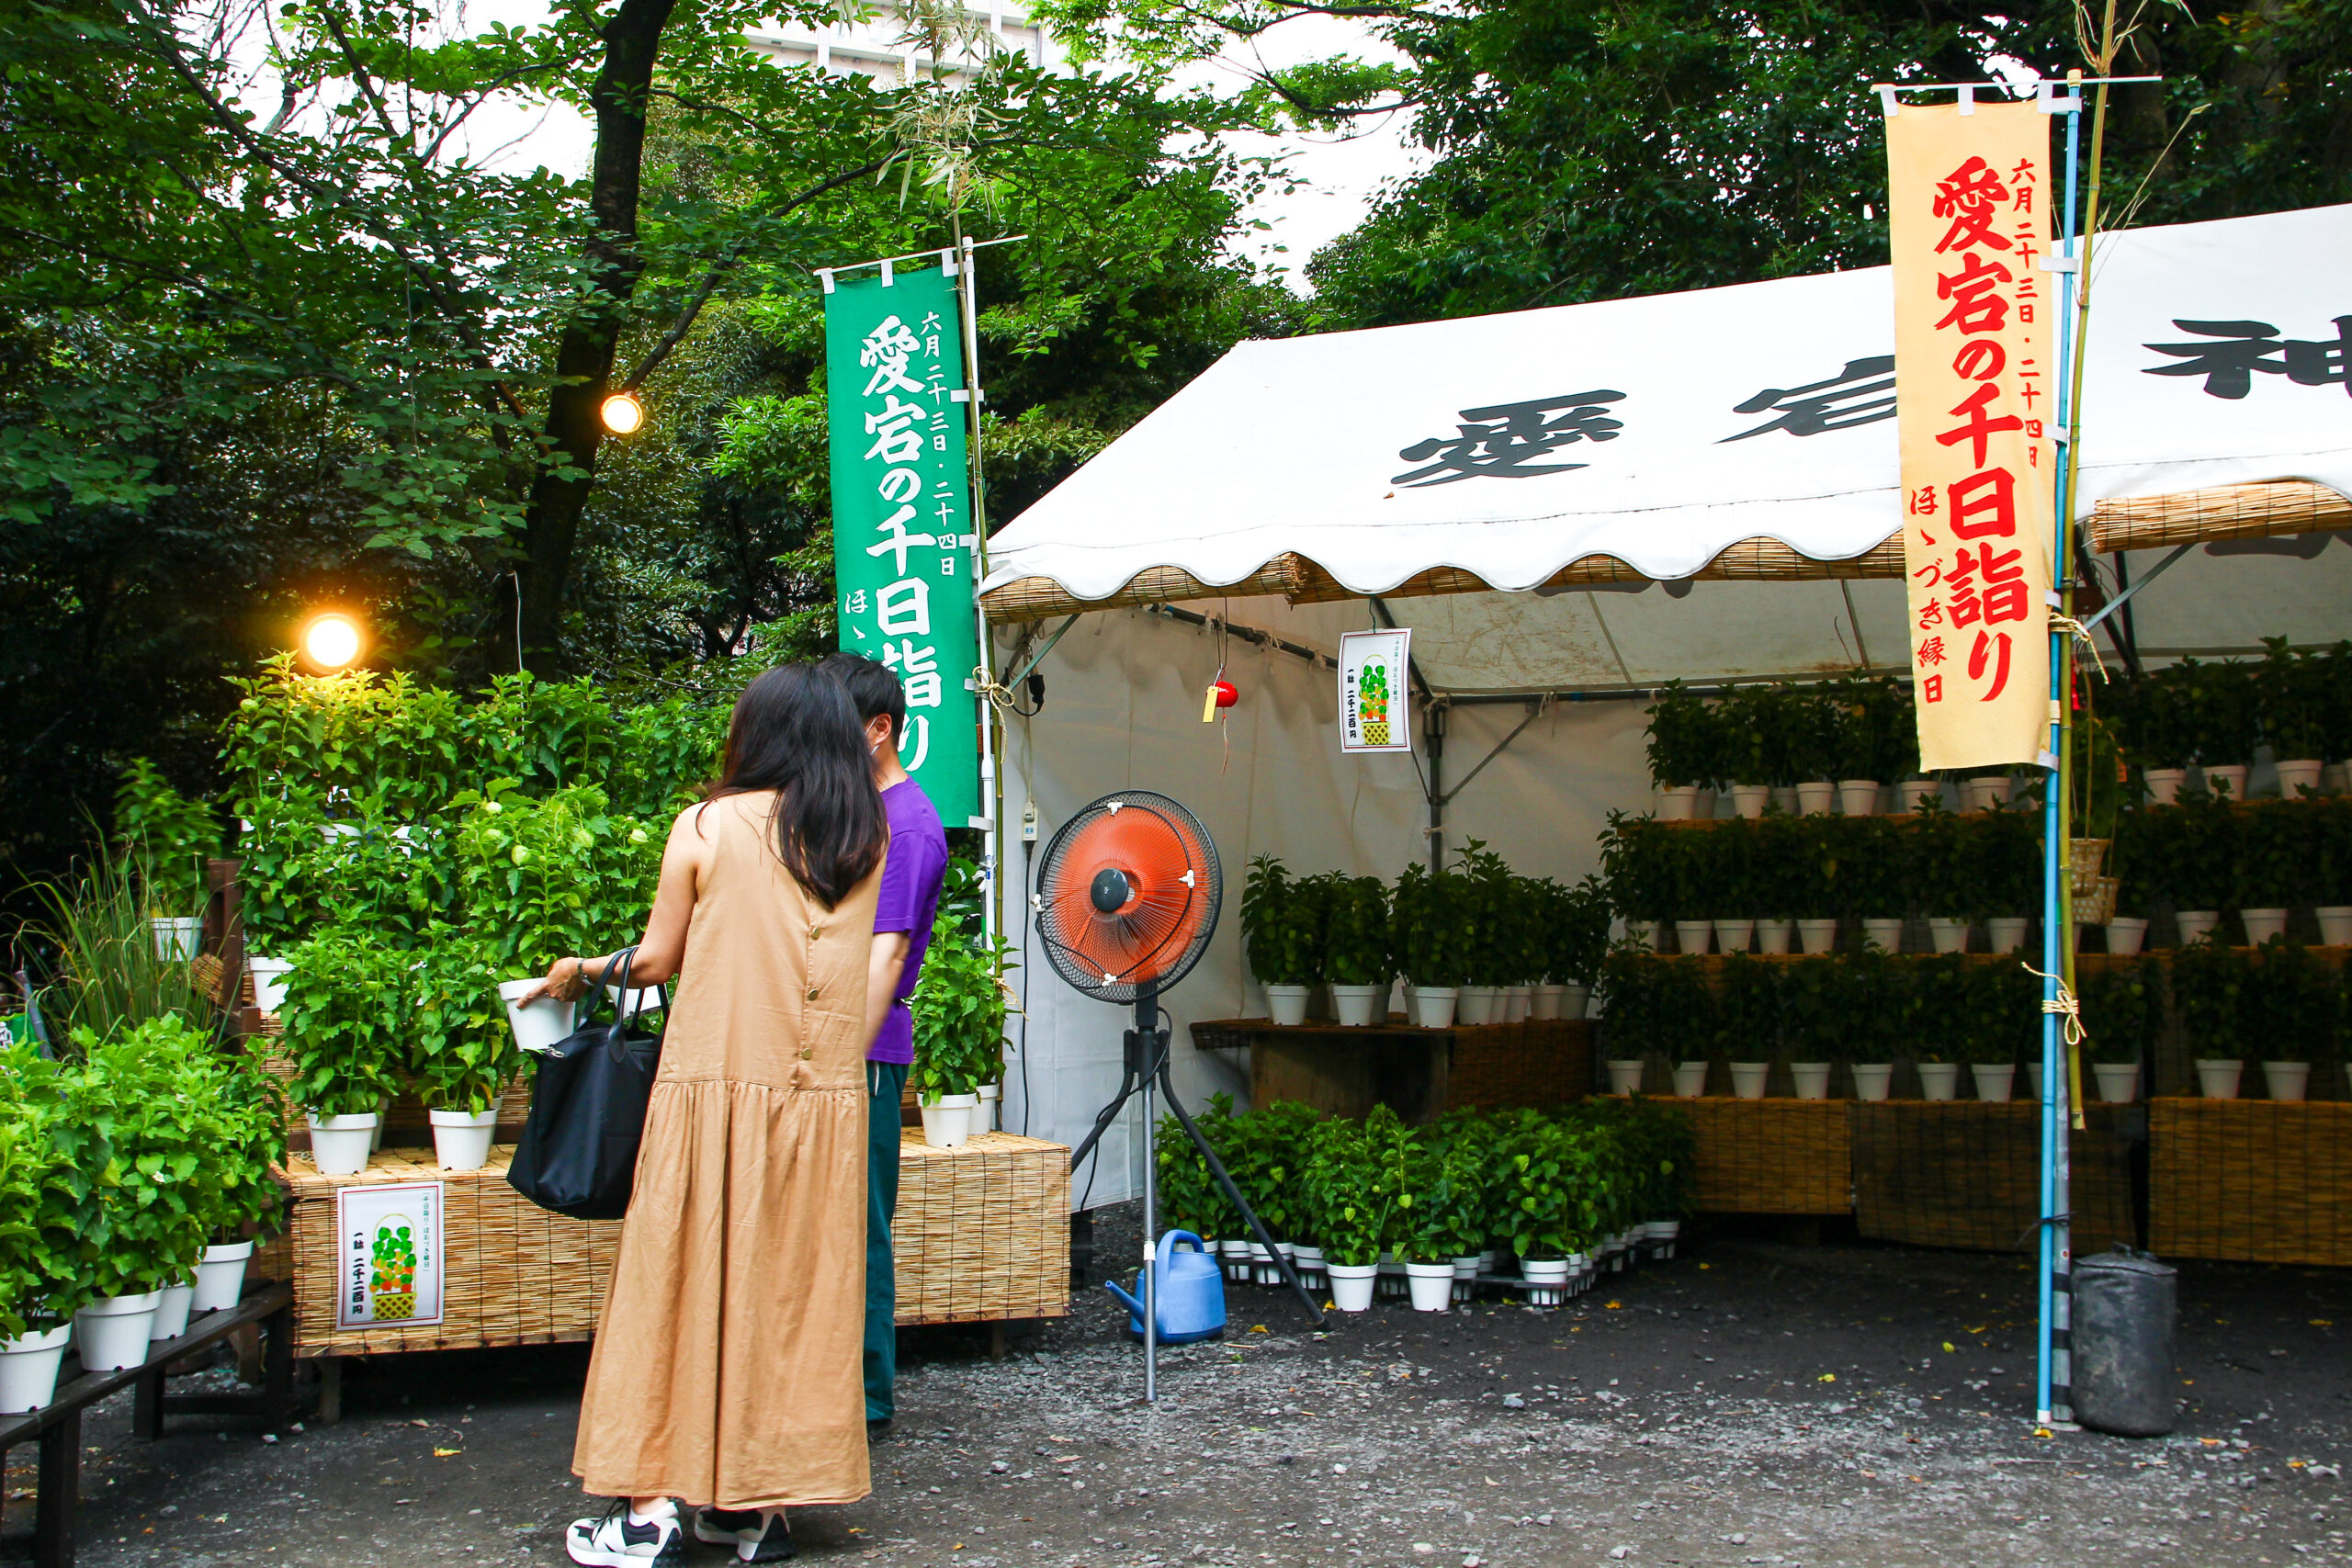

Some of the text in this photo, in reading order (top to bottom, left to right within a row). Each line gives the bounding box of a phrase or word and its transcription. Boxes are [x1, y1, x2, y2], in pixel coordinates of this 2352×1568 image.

[859, 314, 943, 773] 愛宕の千日詣り
[1932, 155, 2029, 703] 愛宕の千日詣り
